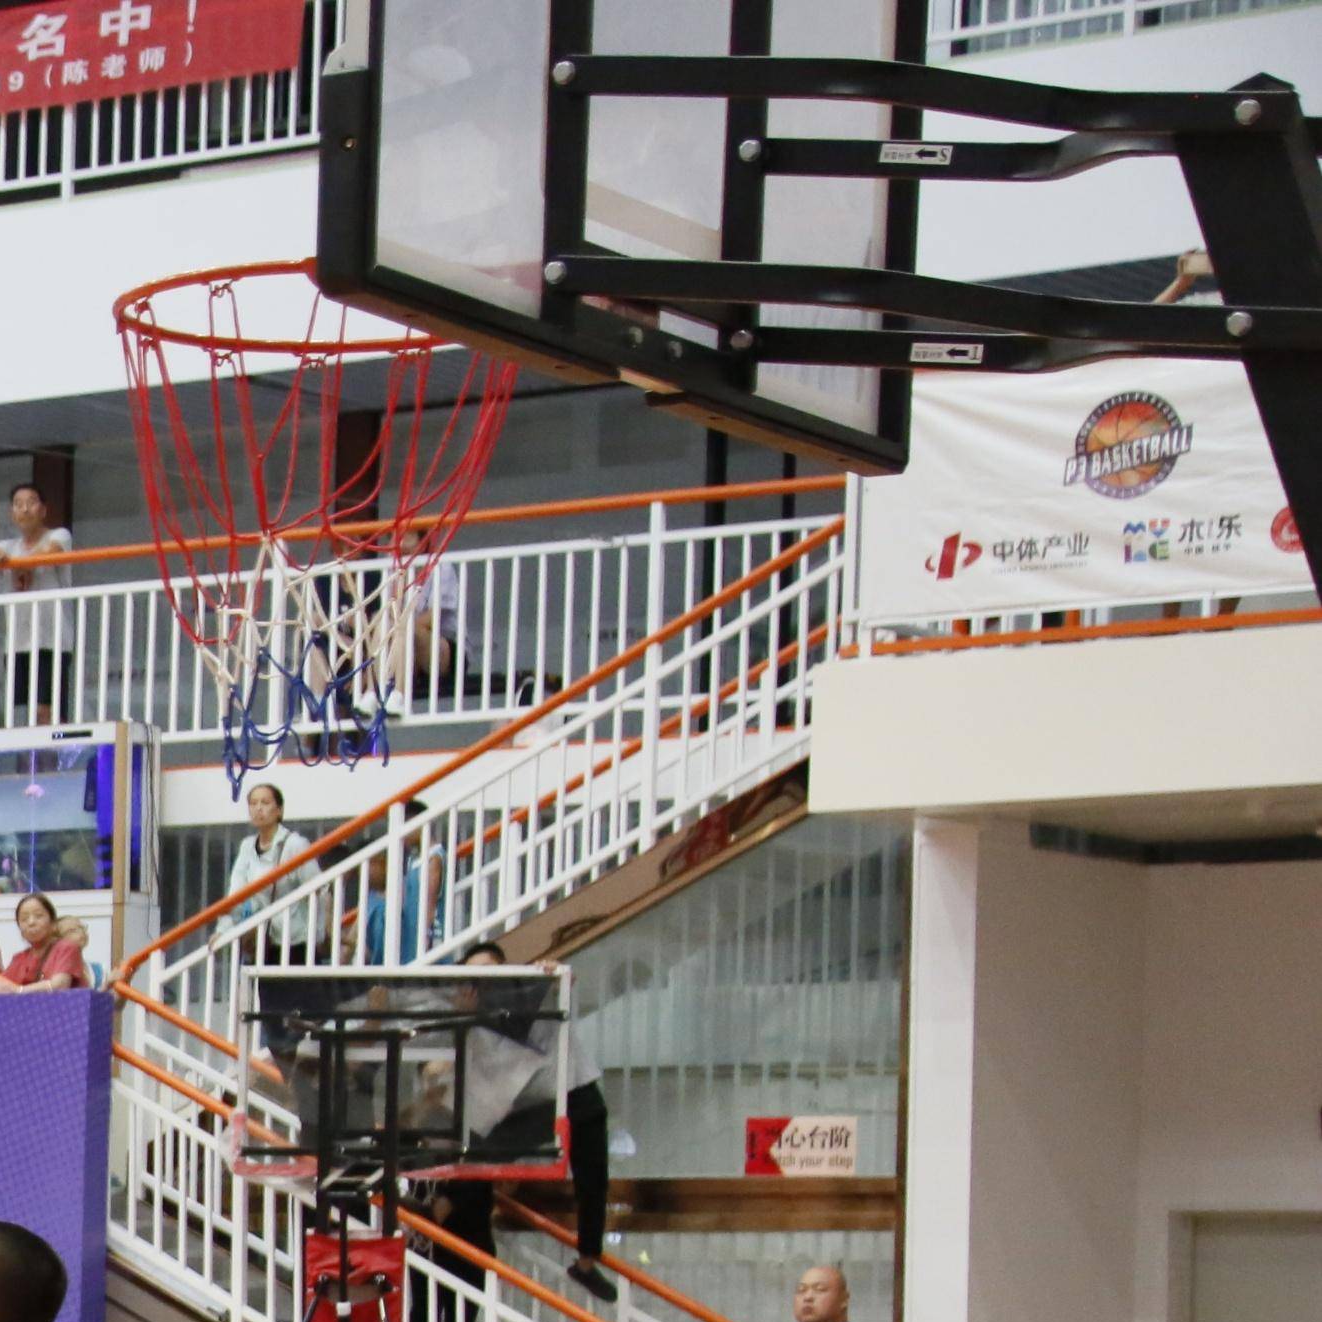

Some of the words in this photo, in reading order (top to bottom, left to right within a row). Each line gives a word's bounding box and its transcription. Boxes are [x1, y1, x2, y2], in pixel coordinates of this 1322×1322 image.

[1090, 424, 1193, 479] BASKETBALL
[993, 532, 1090, 563] 中体产业
